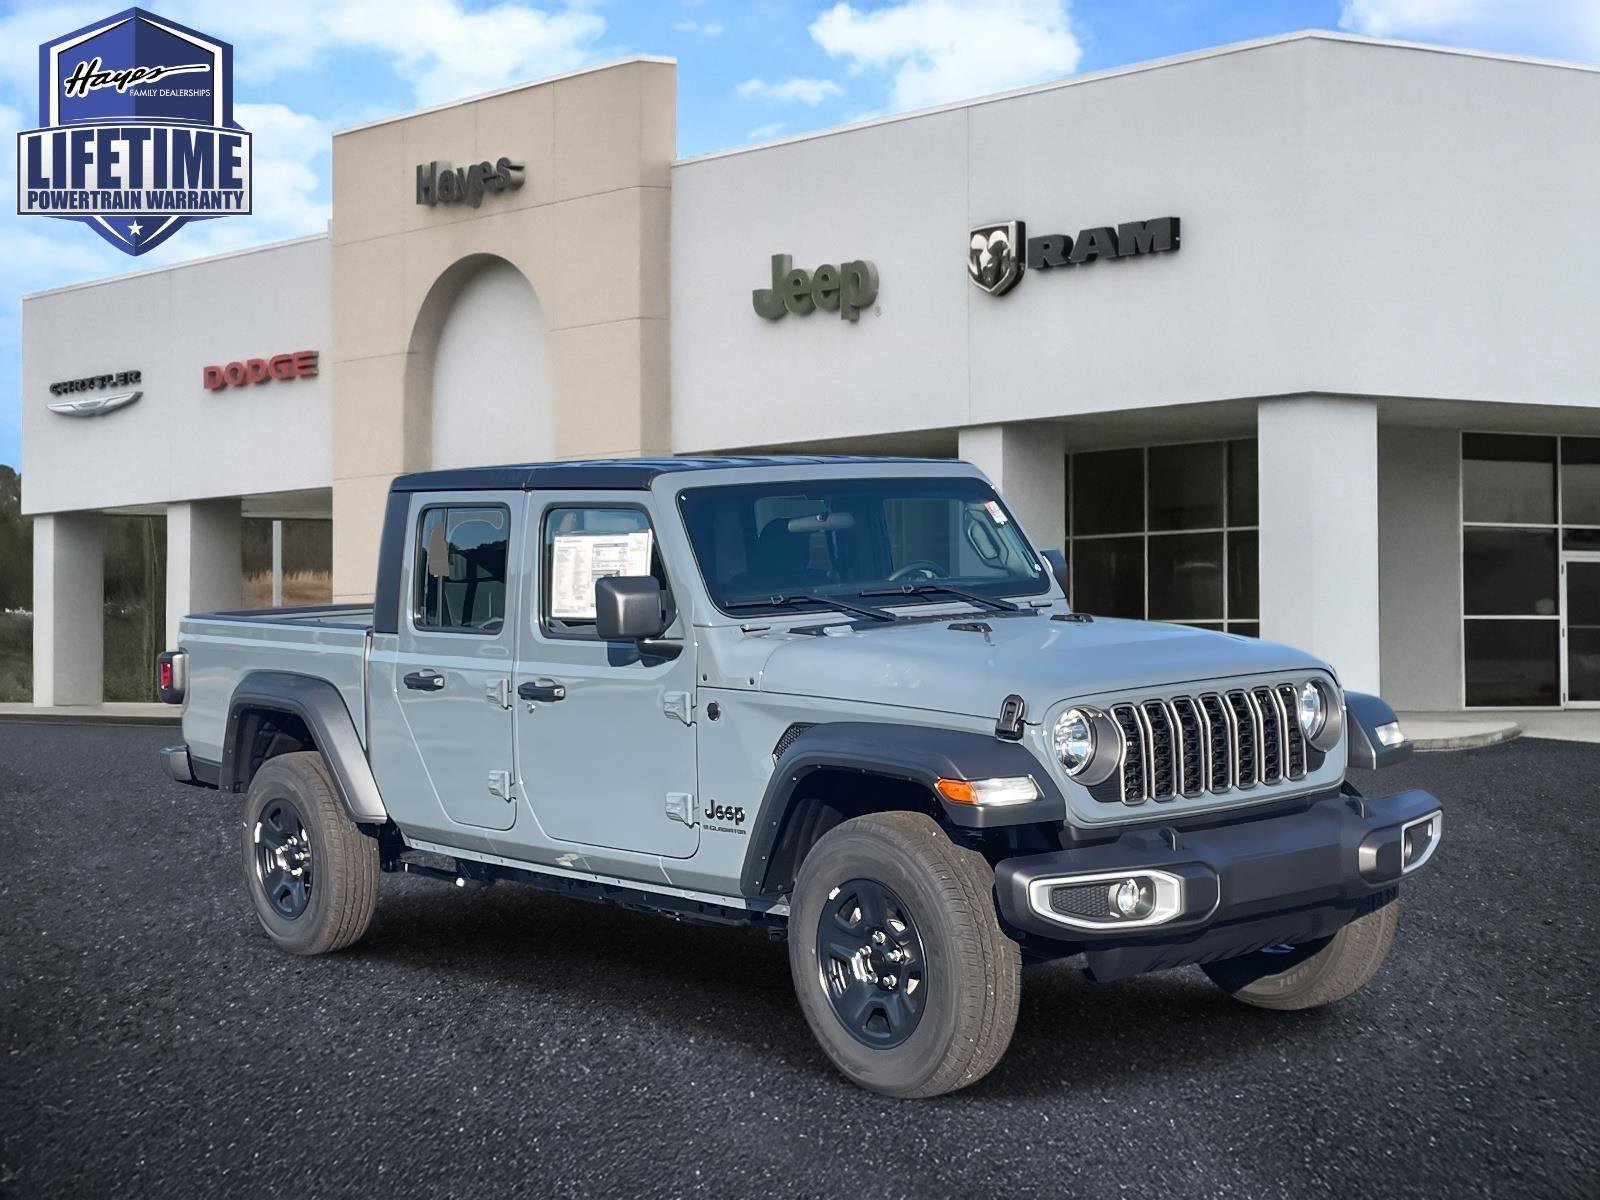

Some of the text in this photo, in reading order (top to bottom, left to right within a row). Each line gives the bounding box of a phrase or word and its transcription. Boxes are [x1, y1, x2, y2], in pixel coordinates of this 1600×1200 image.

[416, 157, 525, 209] Hayes
[1028, 217, 1180, 270] RAM
[752, 254, 879, 321] Jeep
[203, 350, 319, 391] DODGE
[704, 799, 746, 826] Jeep
